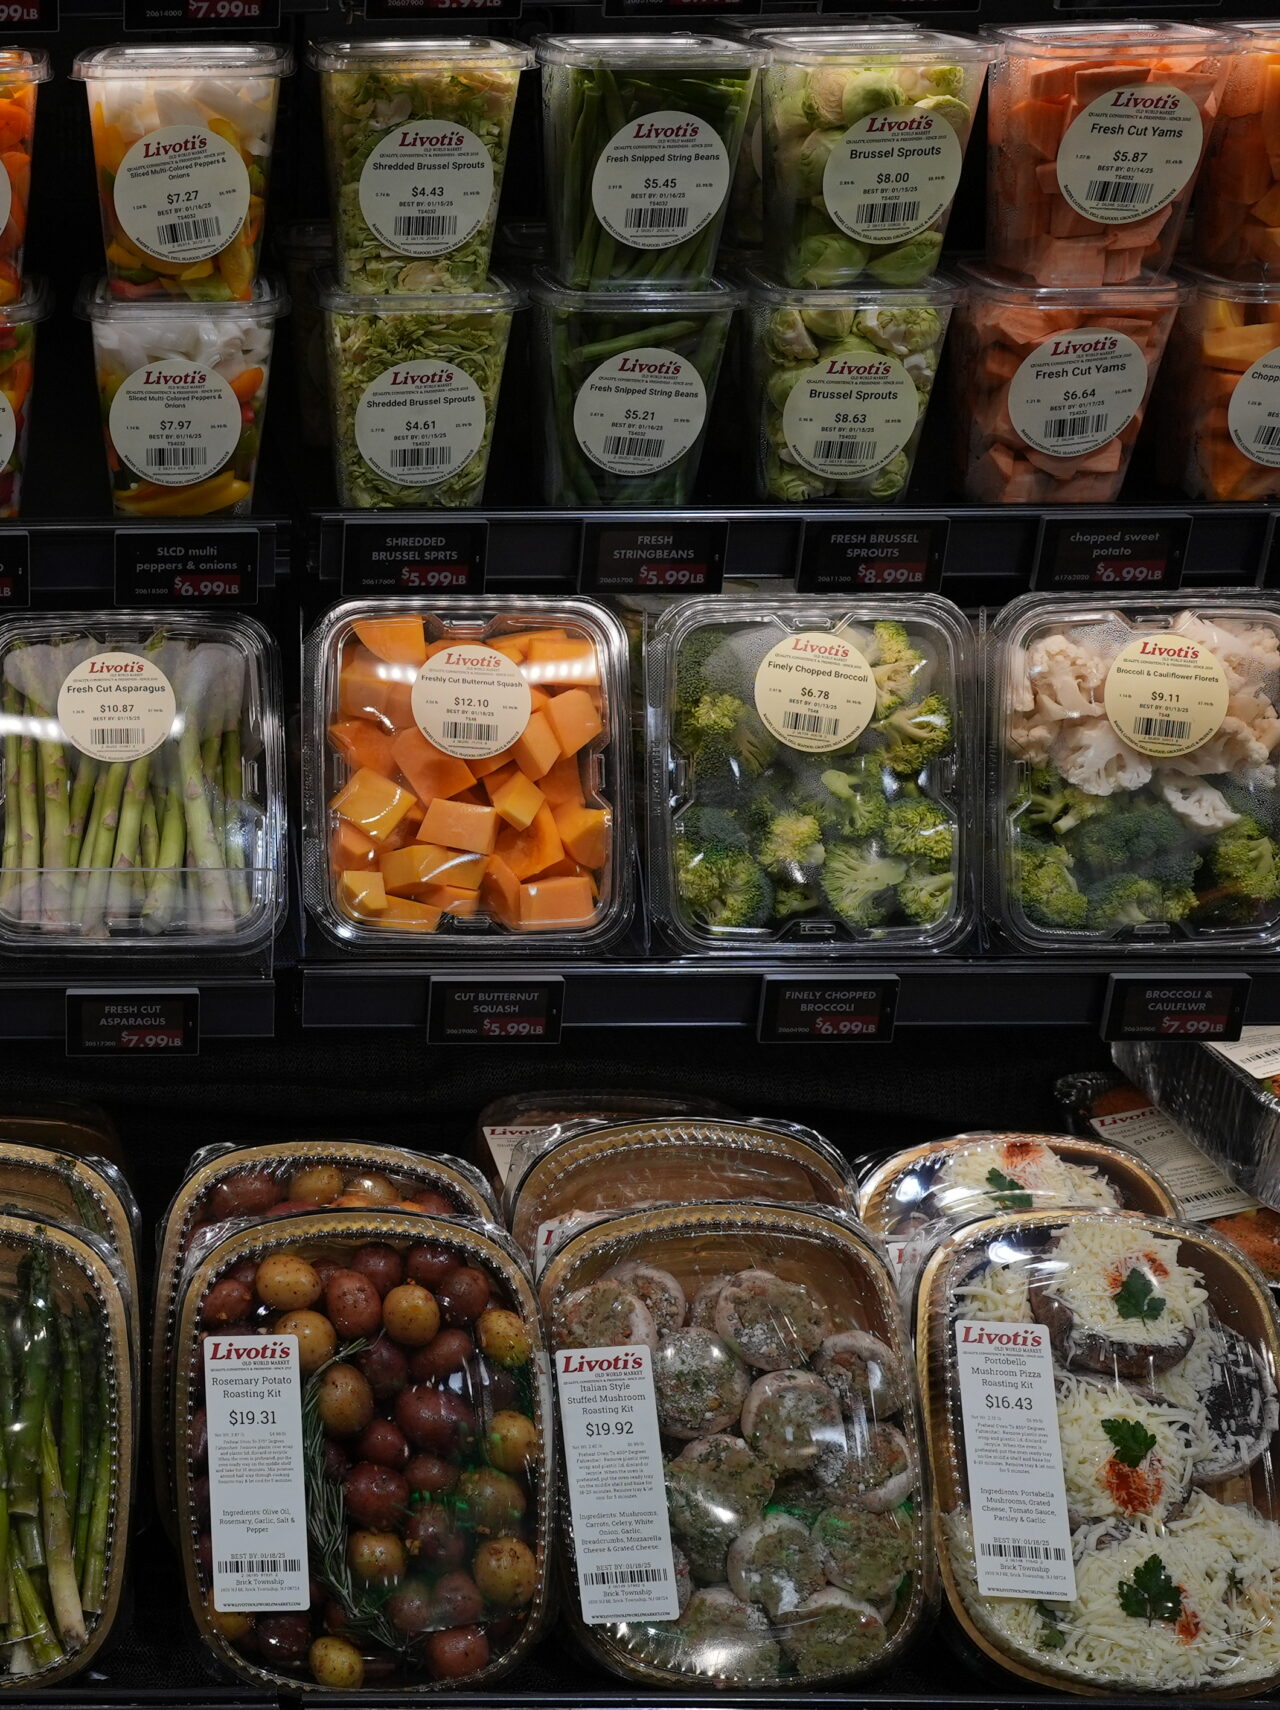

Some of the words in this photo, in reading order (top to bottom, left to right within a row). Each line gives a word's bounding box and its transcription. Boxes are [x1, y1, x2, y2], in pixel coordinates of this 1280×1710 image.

[1111, 92, 1180, 109] Livoti's
[866, 115, 933, 133] Livoti's
[1091, 123, 1124, 135] Fresh
[1128, 125, 1148, 136] Cut
[1152, 127, 1183, 138] Yams
[399, 132, 464, 146] Livoti's
[850, 147, 894, 159] Brussel
[897, 146, 941, 159] Sprouts
[1113, 150, 1148, 162] $5.87
[373, 162, 414, 170] Shredded
[417, 162, 449, 170] Brussel
[452, 162, 484, 171] Sprouts
[877, 173, 909, 184] $8.00
[412, 186, 444, 197] $4.43
[618, 358, 681, 376] Livoti's
[590, 384, 612, 392] Fresh
[614, 386, 647, 395] Snipped
[649, 388, 672, 398] String
[674, 390, 698, 398] Beans
[625, 409, 654, 420] $5.21
[386, 537, 445, 546] SHREDDED
[831, 535, 866, 543] FRESH
[870, 534, 918, 543] BRUSSEL
[1070, 532, 1121, 544] chopped
[1124, 533, 1159, 541] sweet
[372, 552, 420, 560] BRUSSEL
[424, 551, 457, 560] SPRTS
[847, 548, 899, 557] SPROUTS
[1093, 547, 1131, 558] potato
[792, 637, 849, 658] Livoti's
[89, 662, 144, 673] Livoti's
[768, 661, 793, 672] Finely
[795, 665, 832, 677] Chopped
[834, 671, 868, 682] Broccoli
[67, 685, 93, 693] Fresh
[115, 685, 165, 693] Asparagus
[801, 687, 829, 699] $6.78
[100, 704, 134, 713] $10.87
[825, 991, 876, 999] CHOPPED
[962, 1326, 1041, 1347] Livoti's
[210, 1342, 290, 1360] Livoti's
[985, 1357, 1026, 1366] Portobello
[971, 1367, 1017, 1376] Mushroom
[1019, 1370, 1041, 1378] Pizza
[212, 1378, 259, 1386] Rosemary
[262, 1376, 291, 1384] Potato
[982, 1379, 1018, 1390] Roasting
[223, 1390, 264, 1399] Roasting
[267, 1389, 280, 1397] Kit
[986, 1394, 1032, 1410] $16.43
[229, 1410, 276, 1426] $19.31
